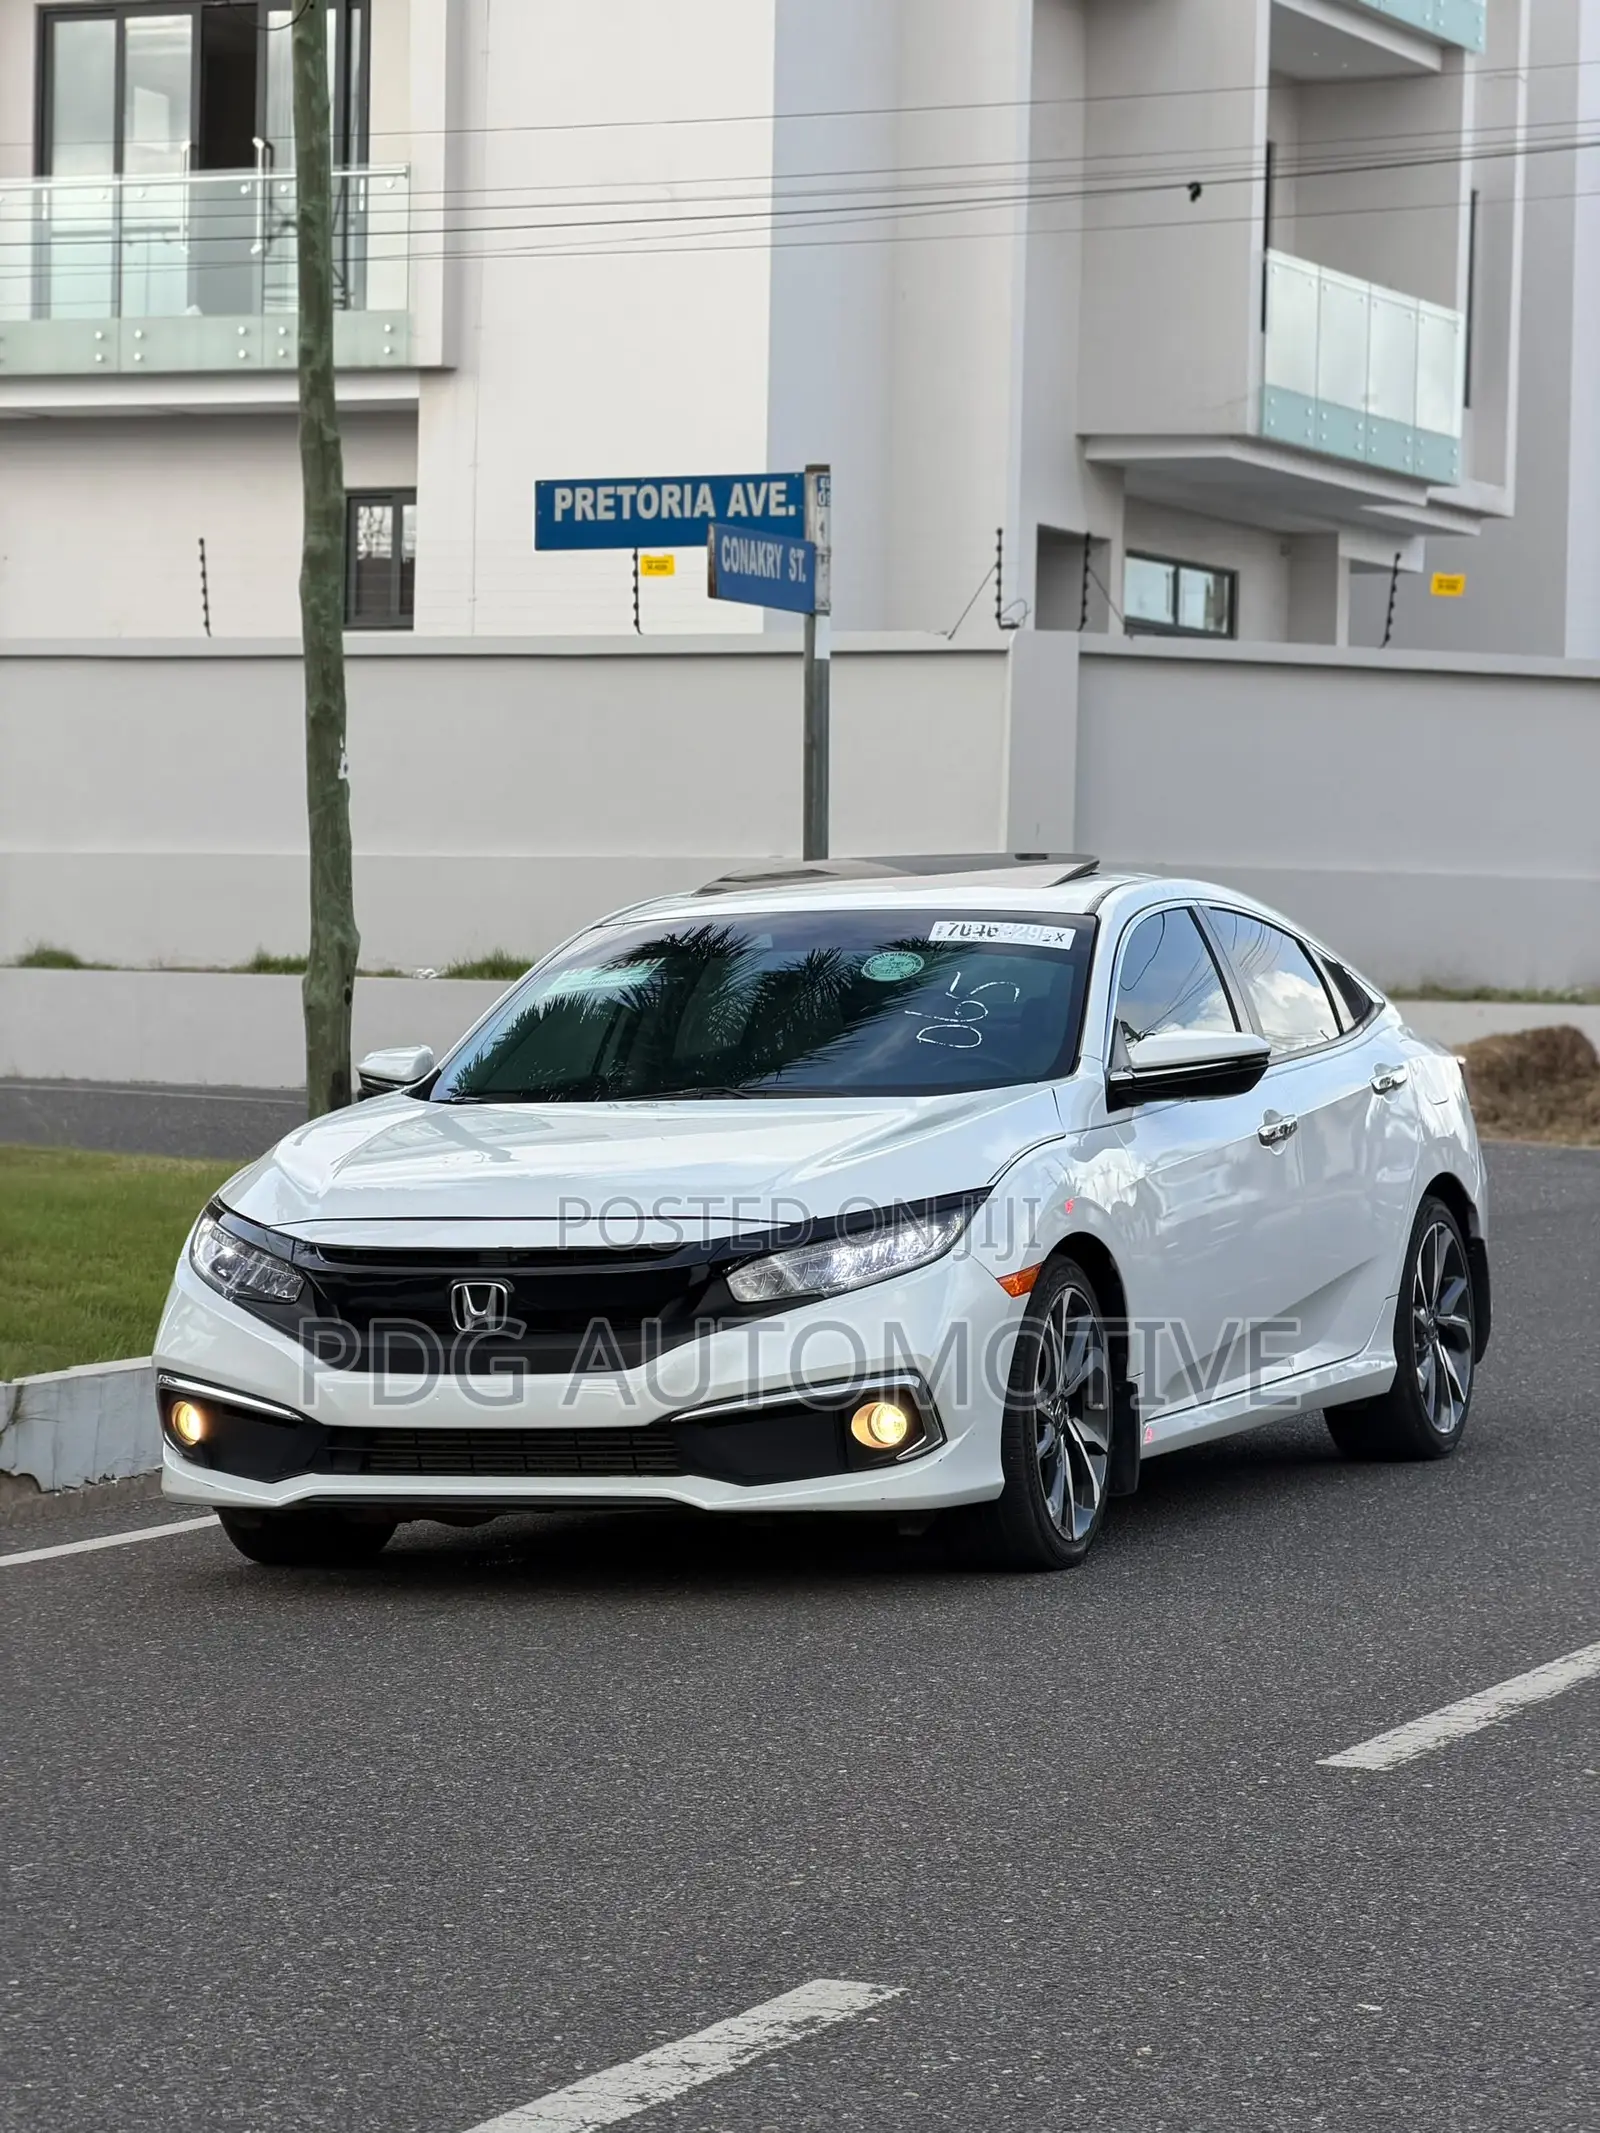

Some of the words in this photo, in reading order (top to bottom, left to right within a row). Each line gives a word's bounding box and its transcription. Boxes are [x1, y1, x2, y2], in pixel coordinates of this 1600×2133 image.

[554, 483, 716, 522] PRETORIA
[726, 481, 796, 518] AVE.
[721, 535, 783, 580] CONAKRY
[788, 547, 807, 583] ST.
